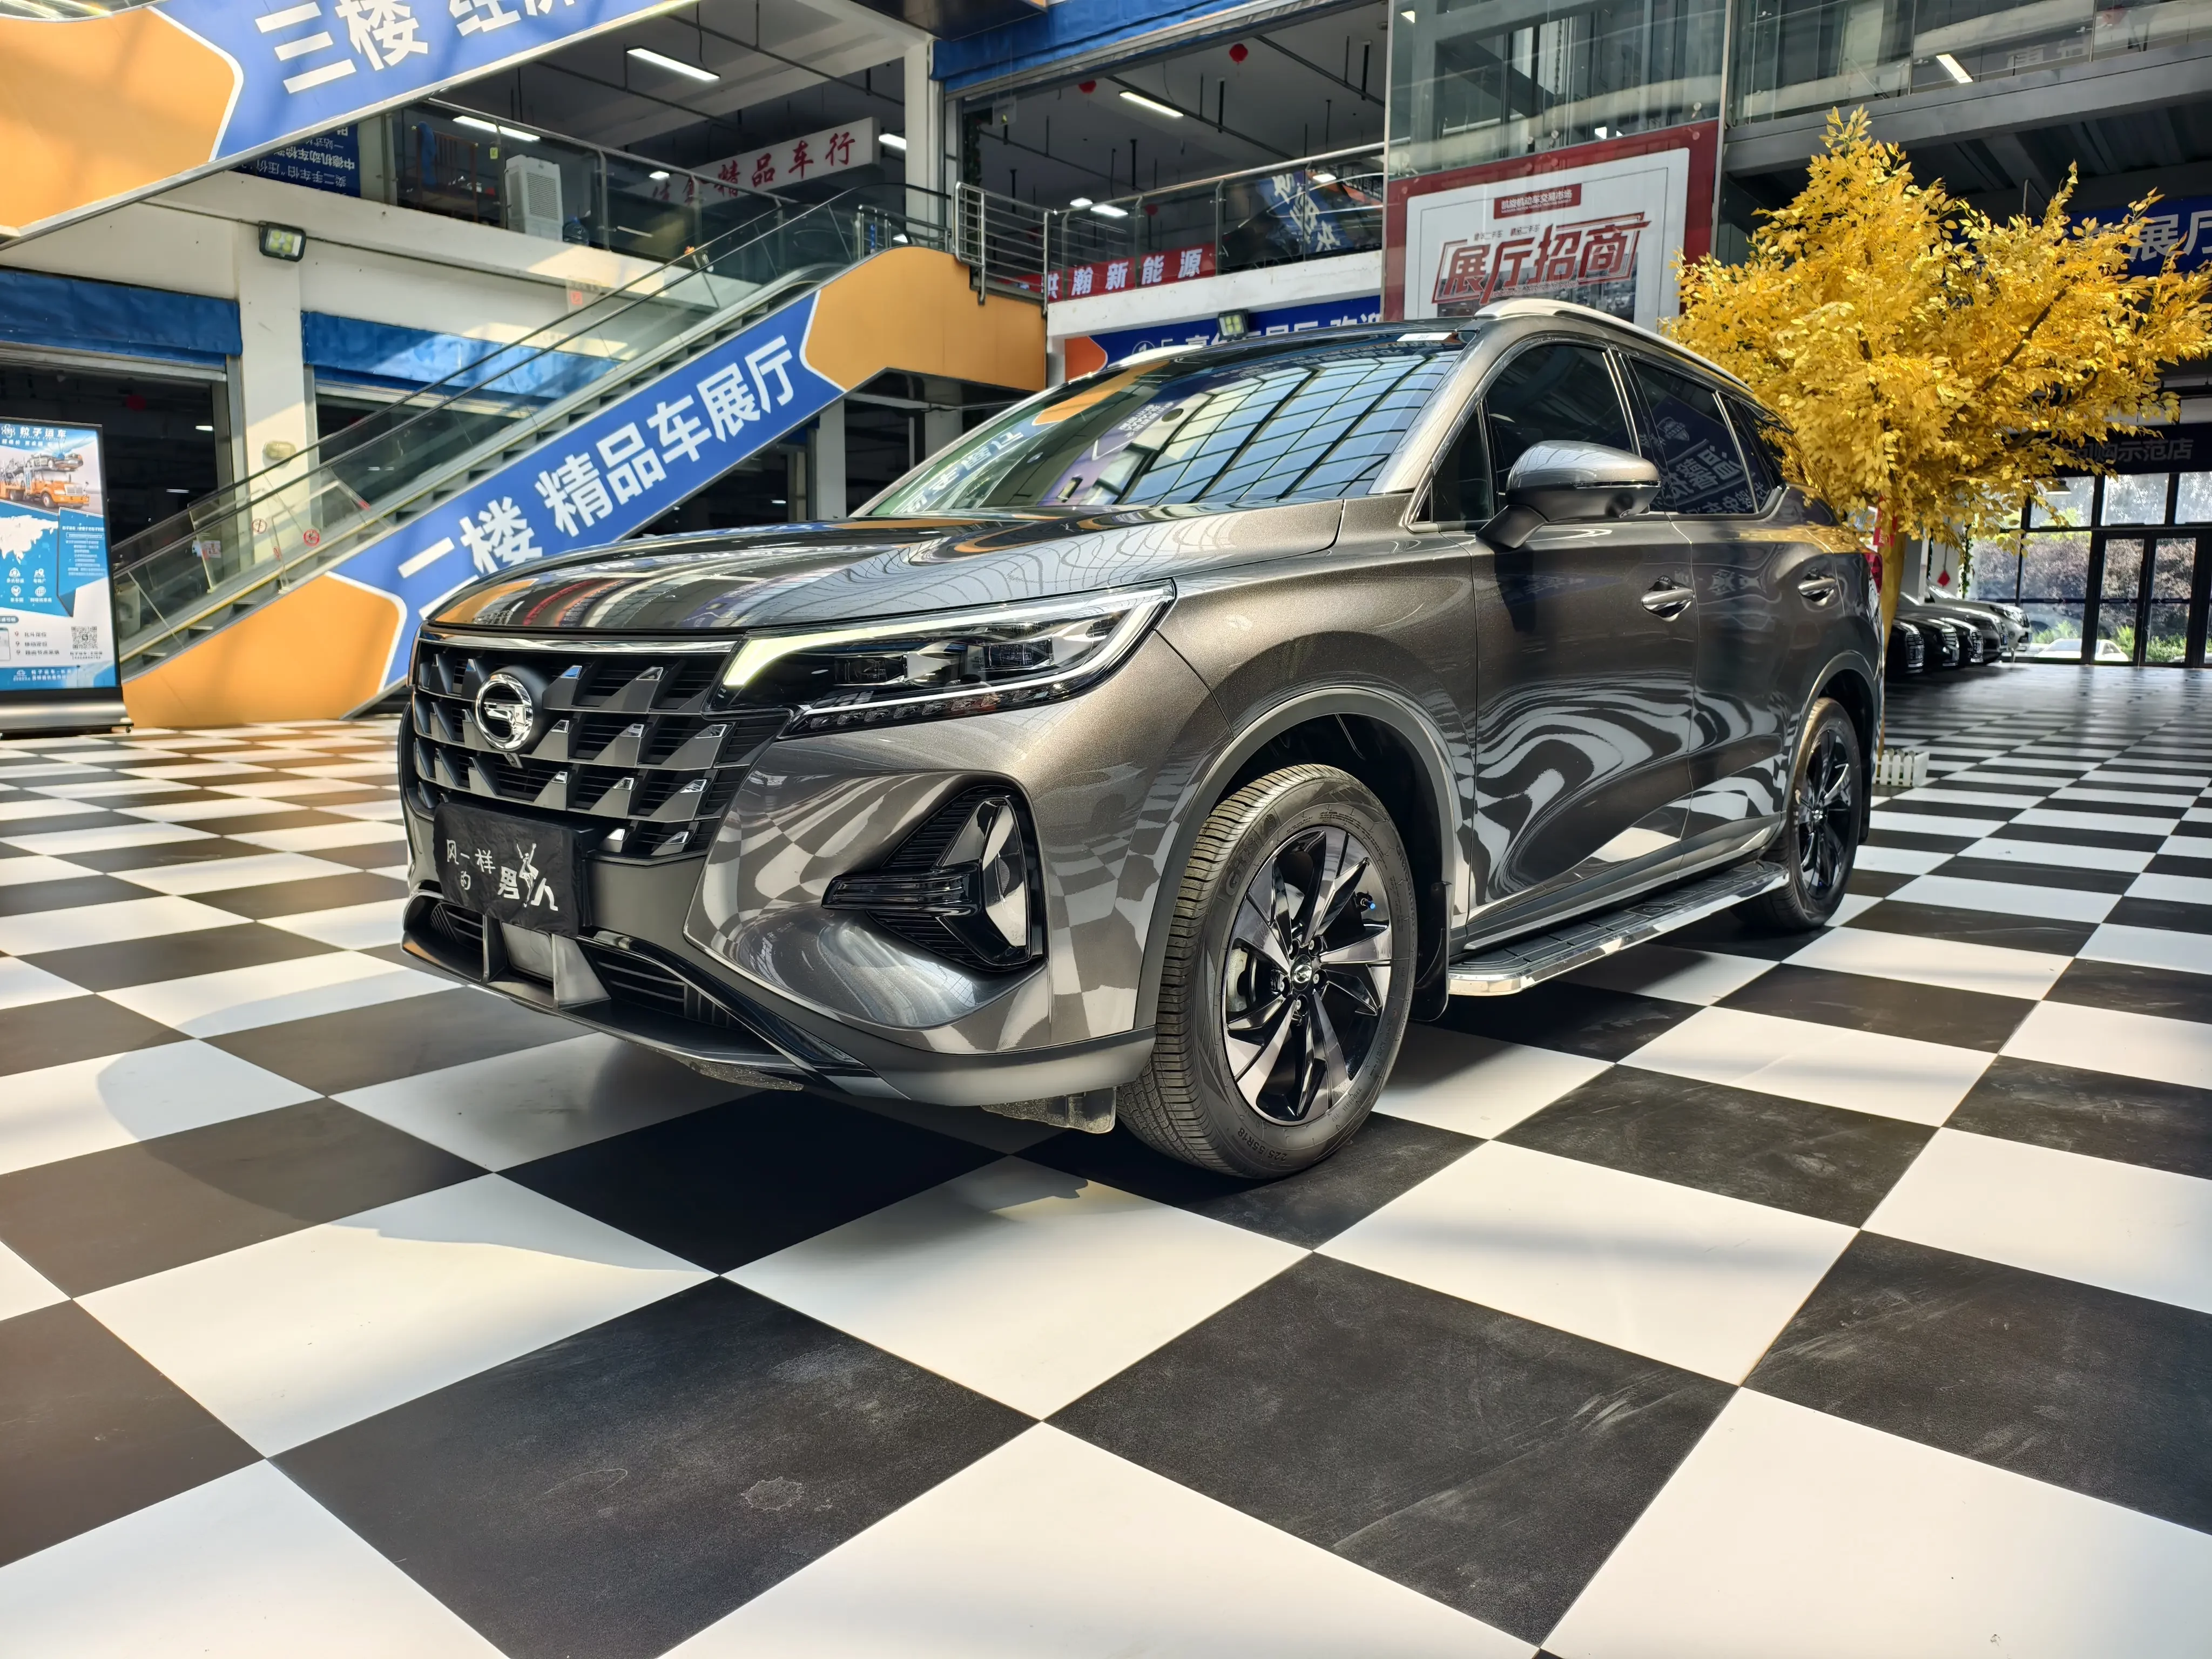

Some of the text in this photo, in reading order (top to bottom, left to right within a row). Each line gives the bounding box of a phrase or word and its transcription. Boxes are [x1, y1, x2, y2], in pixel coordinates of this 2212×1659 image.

[255, 0, 428, 94] 三楼
[1442, 222, 1650, 305] 展厅招商
[535, 335, 794, 537] 精品车展厅
[447, 839, 496, 874] 风一样
[460, 870, 471, 891] 的
[1237, 1128, 1288, 1162] 225/55R18
